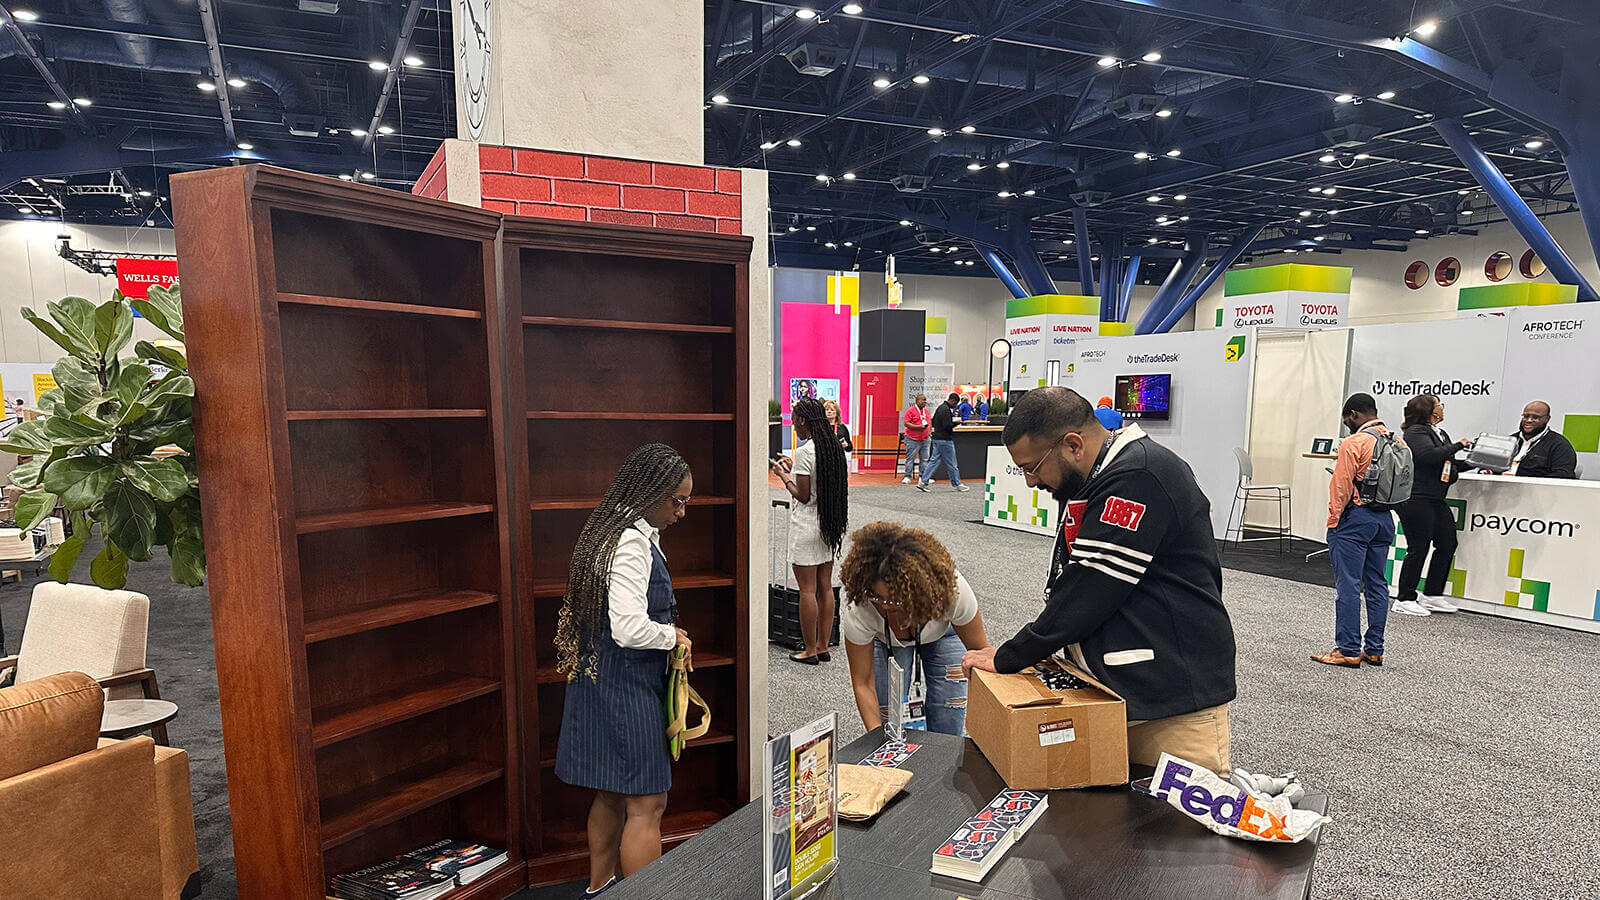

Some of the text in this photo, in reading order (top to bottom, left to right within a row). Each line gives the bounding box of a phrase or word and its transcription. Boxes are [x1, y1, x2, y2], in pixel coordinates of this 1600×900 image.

[122, 273, 160, 283] WELLS
[1234, 304, 1275, 317] TOYOTA
[1301, 303, 1339, 315] TOYOTA
[1244, 317, 1274, 326] LEXUS
[1310, 318, 1338, 326] LEXUS
[1522, 319, 1583, 332] AFROTECH
[1020, 326, 1041, 334] NATION
[1528, 331, 1574, 340] CONFERENCE
[1134, 353, 1178, 364] theTradeDesk
[1388, 380, 1491, 396] theTradeDesk
[1470, 513, 1574, 538] paycom
[1158, 760, 1293, 841] FedEx
[346, 860, 399, 879] HOWARD
